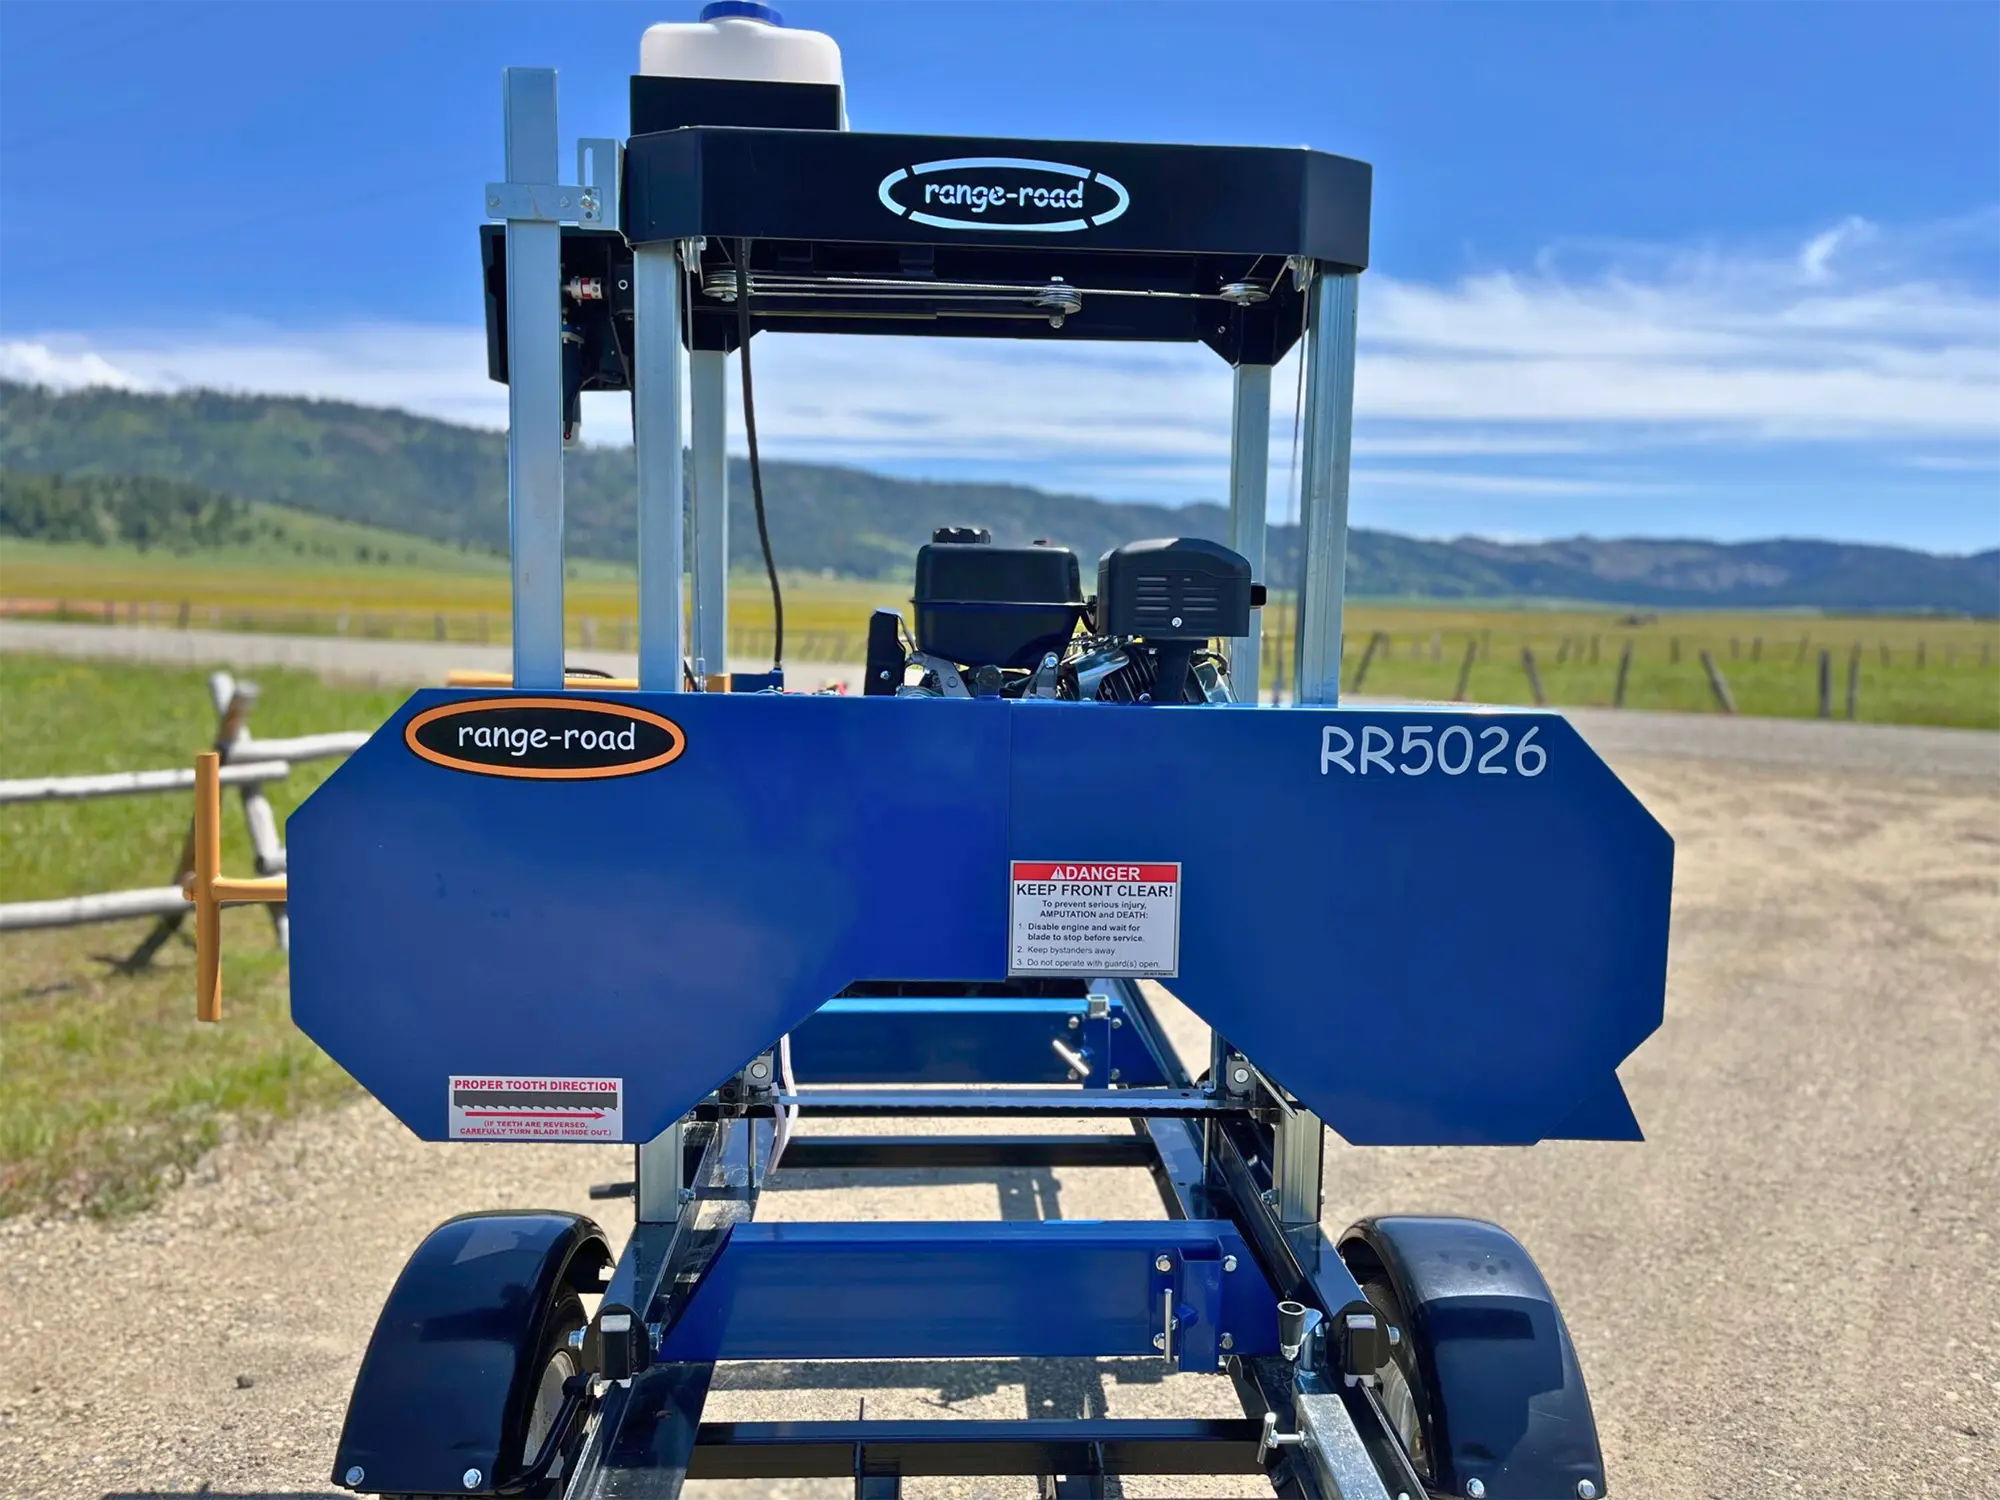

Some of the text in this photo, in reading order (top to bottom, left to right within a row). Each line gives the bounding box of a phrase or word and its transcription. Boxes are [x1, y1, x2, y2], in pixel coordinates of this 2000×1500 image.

[925, 181, 1084, 213] range-road
[458, 722, 636, 756] range-road
[1320, 725, 1547, 777] RR5026
[1066, 866, 1141, 881] DANGER
[1016, 883, 1173, 898] KEEP FRONT CLEAR!
[1043, 900, 1147, 910] To prevent serious injury,
[1040, 910, 1149, 920] AMPUTATION and DEATH:
[1028, 922, 1060, 931] Disable
[1061, 924, 1090, 933] engine
[1091, 924, 1107, 932] and
[1109, 924, 1127, 932] wait
[1128, 924, 1141, 932] for
[1027, 933, 1051, 941] blade
[1063, 934, 1083, 943] stop
[1084, 934, 1111, 942] before
[1112, 934, 1146, 942] service.
[1027, 946, 1049, 955] Keep
[1049, 946, 1093, 956] bystanders
[1027, 958, 1039, 967] Do
[1040, 959, 1053, 967] not
[1055, 960, 1085, 968] operate
[1086, 960, 1103, 968] with
[1104, 960, 1138, 969] guard(s)
[454, 1079, 617, 1092] PROPER TOOTH DIRECTION
[484, 1120, 494, 1128] (IF
[460, 1127, 506, 1135] CAREFULLY
[533, 1128, 560, 1136] BLADE
